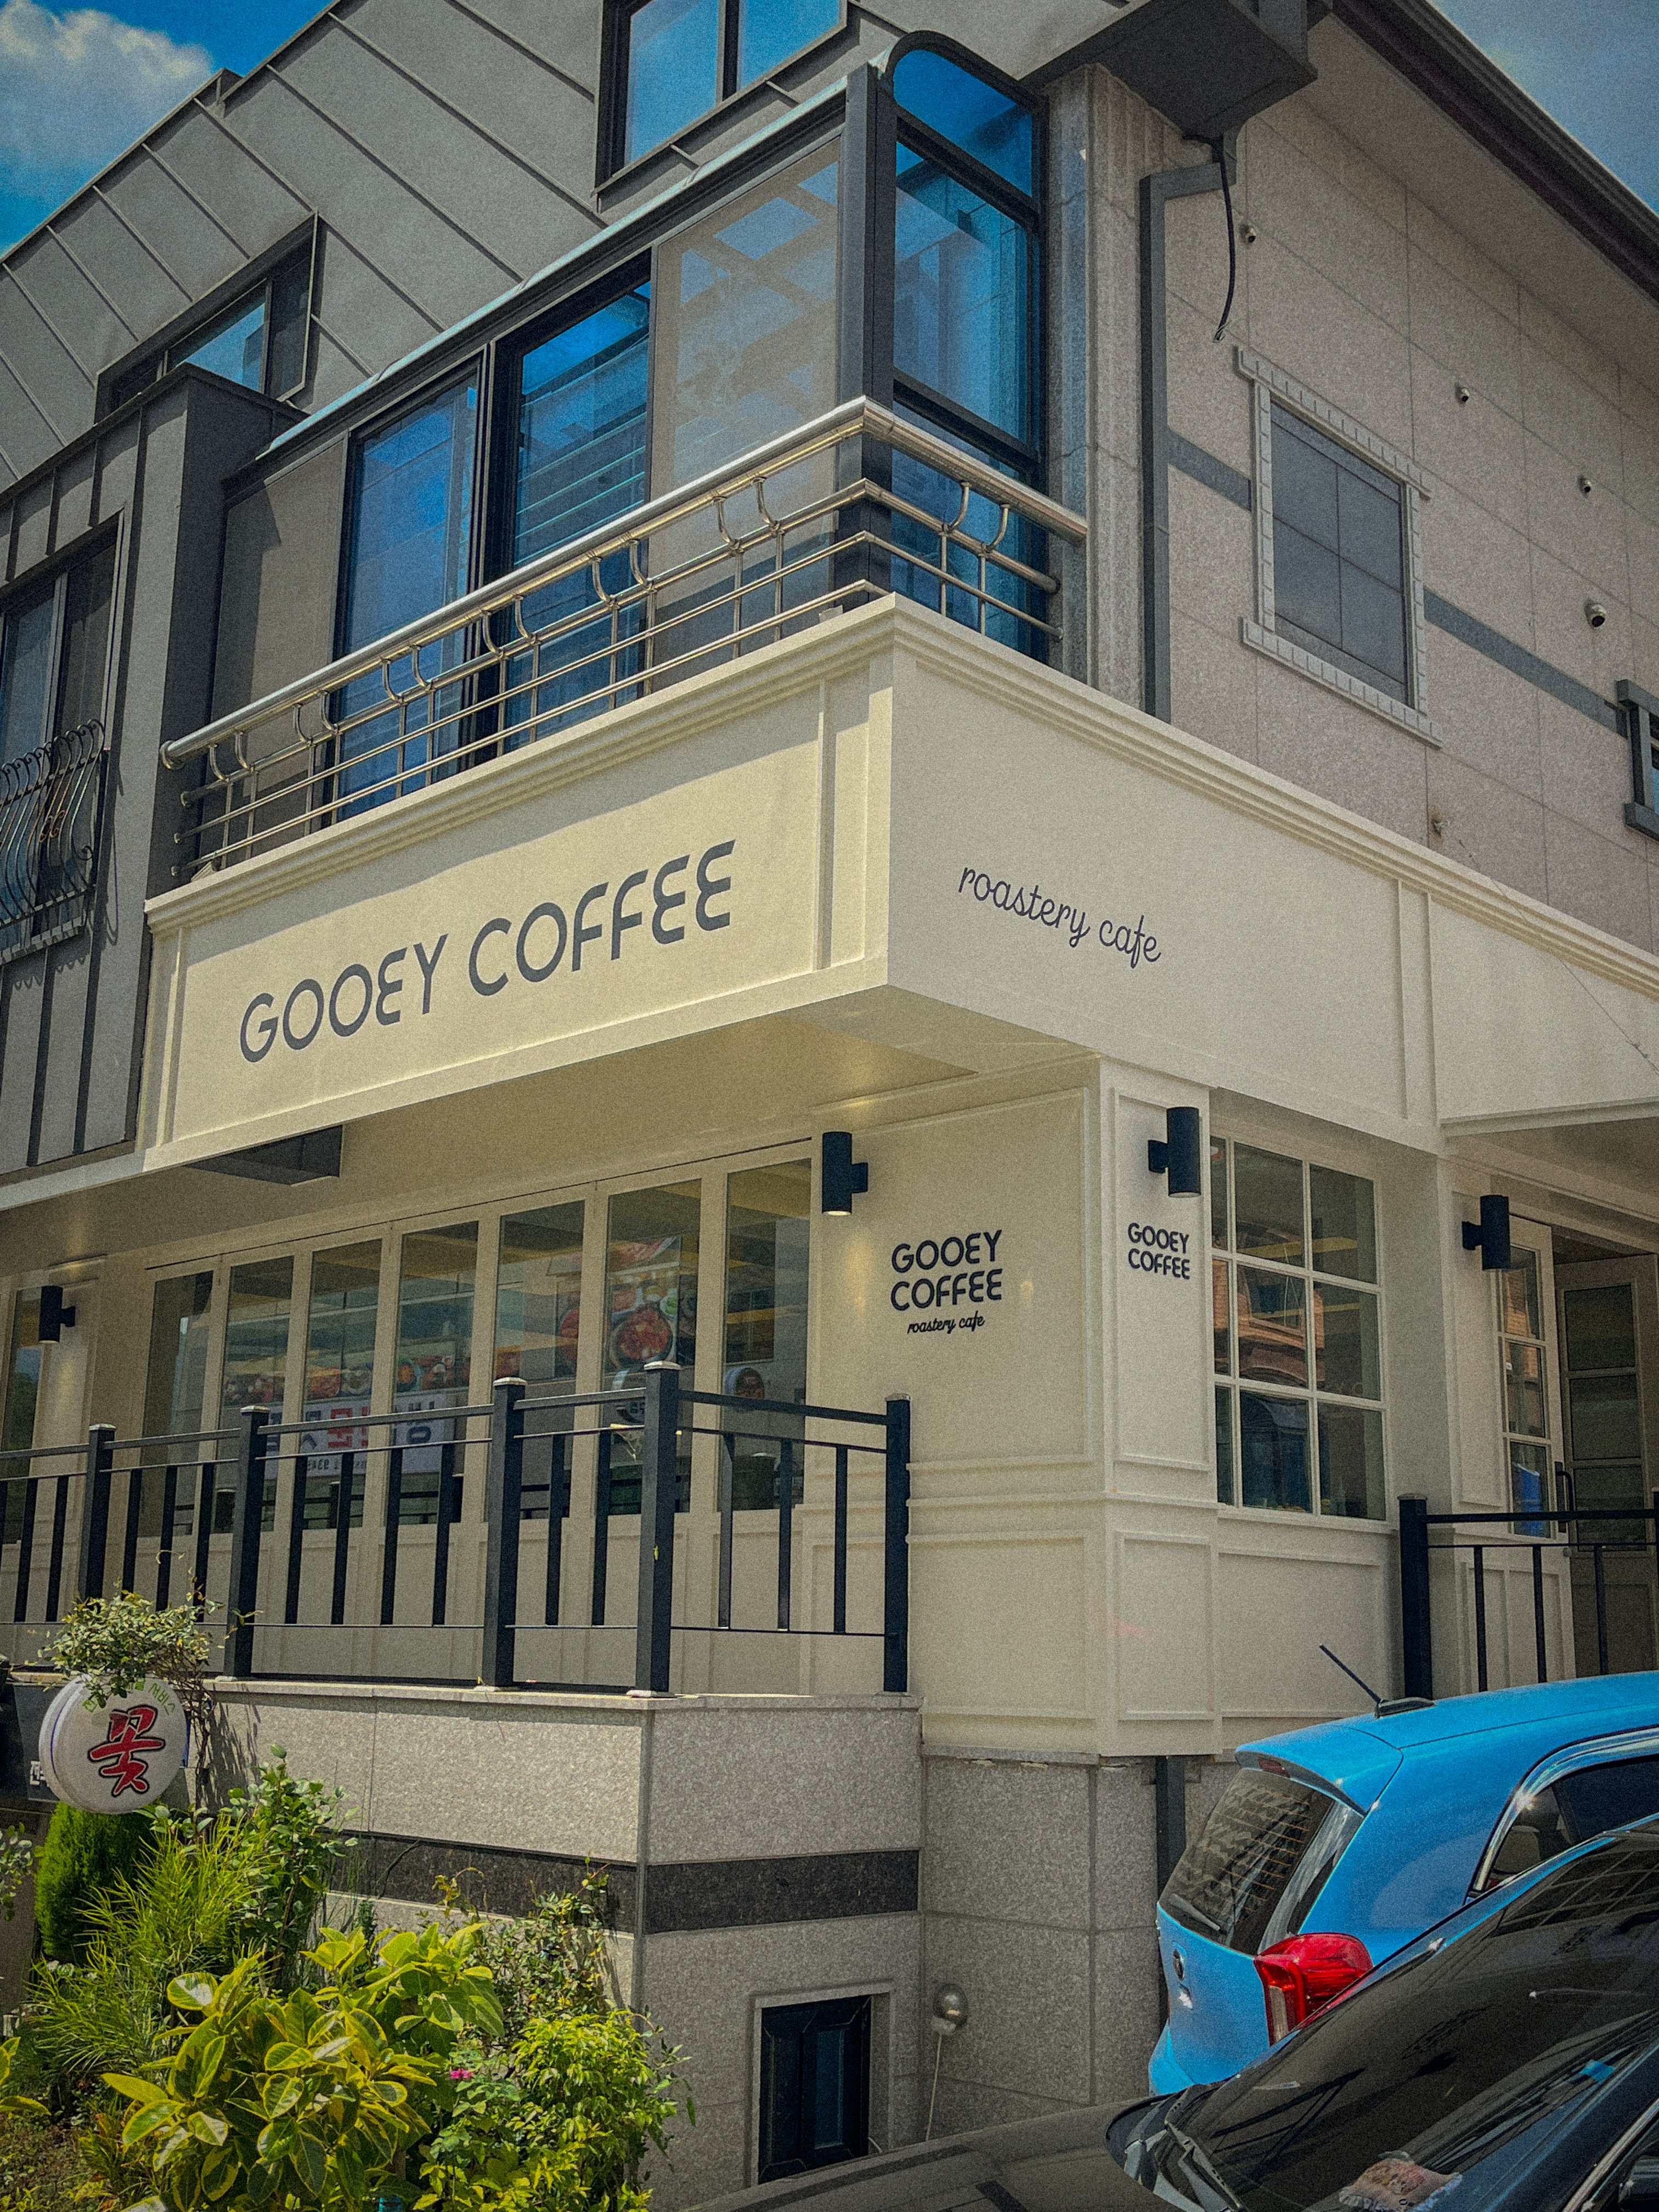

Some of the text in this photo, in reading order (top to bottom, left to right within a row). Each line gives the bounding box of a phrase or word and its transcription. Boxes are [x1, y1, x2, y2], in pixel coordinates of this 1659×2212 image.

[958, 867, 1162, 969] roastery cafe
[240, 839, 736, 1063] GOOEY COFFEE
[891, 1229, 1003, 1273] GOOEY
[1127, 1222, 1189, 1254] GOOEY
[1128, 1248, 1190, 1280] COFFEE
[890, 1268, 1003, 1311] COFFEE
[907, 1310, 985, 1334] roastery cafe
[87, 1702, 166, 1797] 꽃
